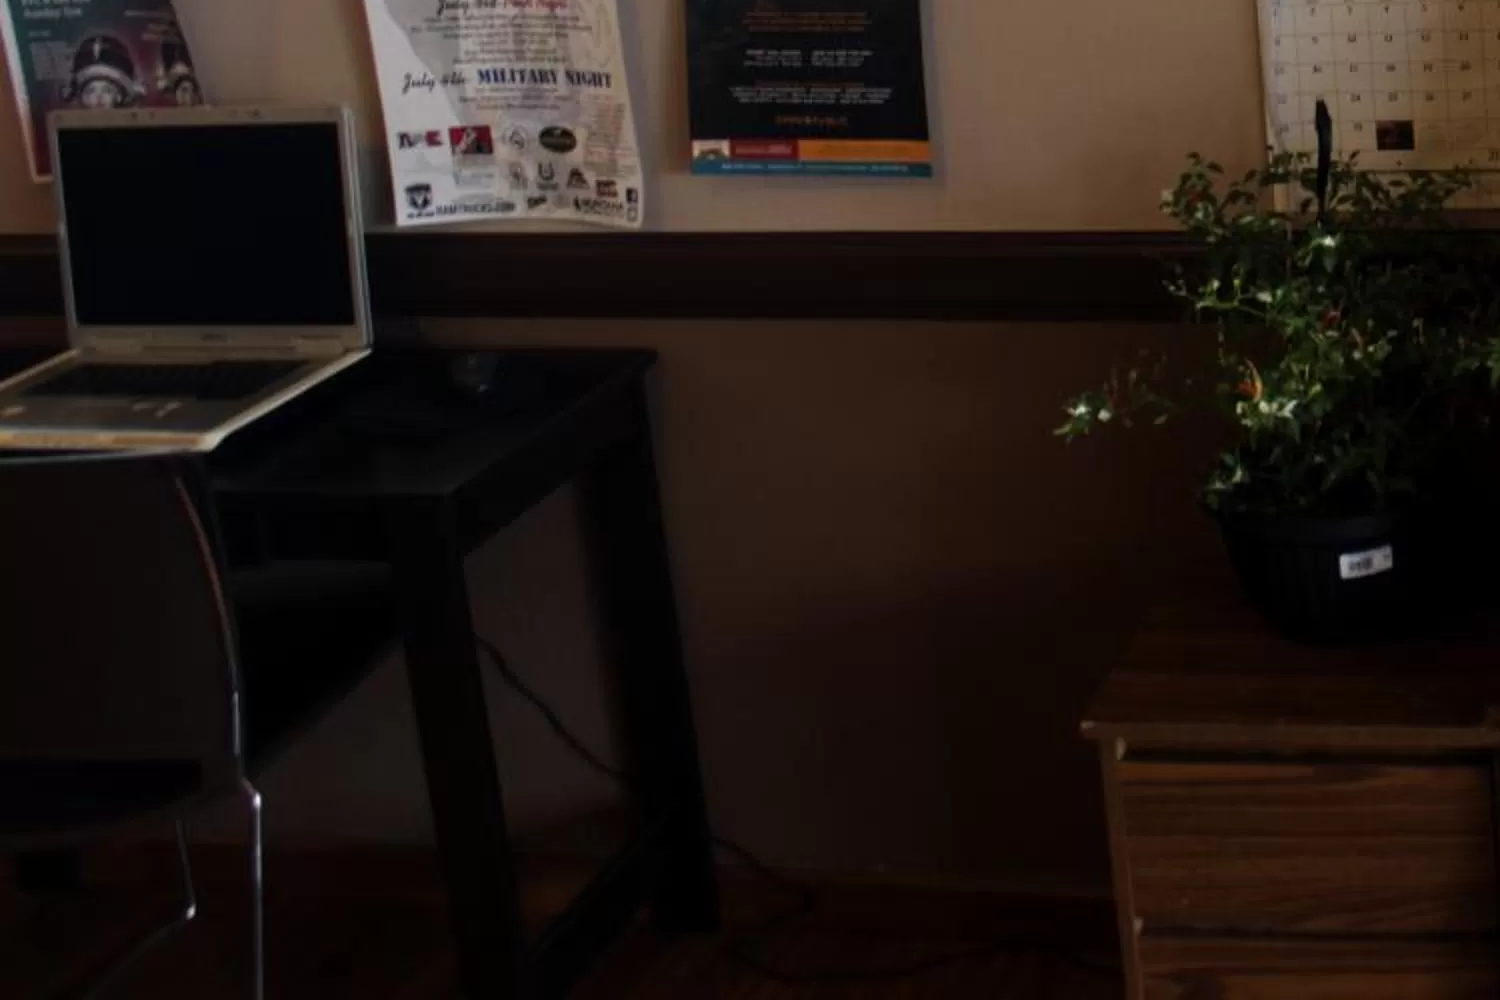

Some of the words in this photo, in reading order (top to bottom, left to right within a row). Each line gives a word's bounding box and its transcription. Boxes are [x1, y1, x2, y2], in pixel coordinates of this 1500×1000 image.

[401, 71, 436, 94] July
[476, 68, 561, 86] MILITARY
[564, 69, 613, 89] NIGHT
